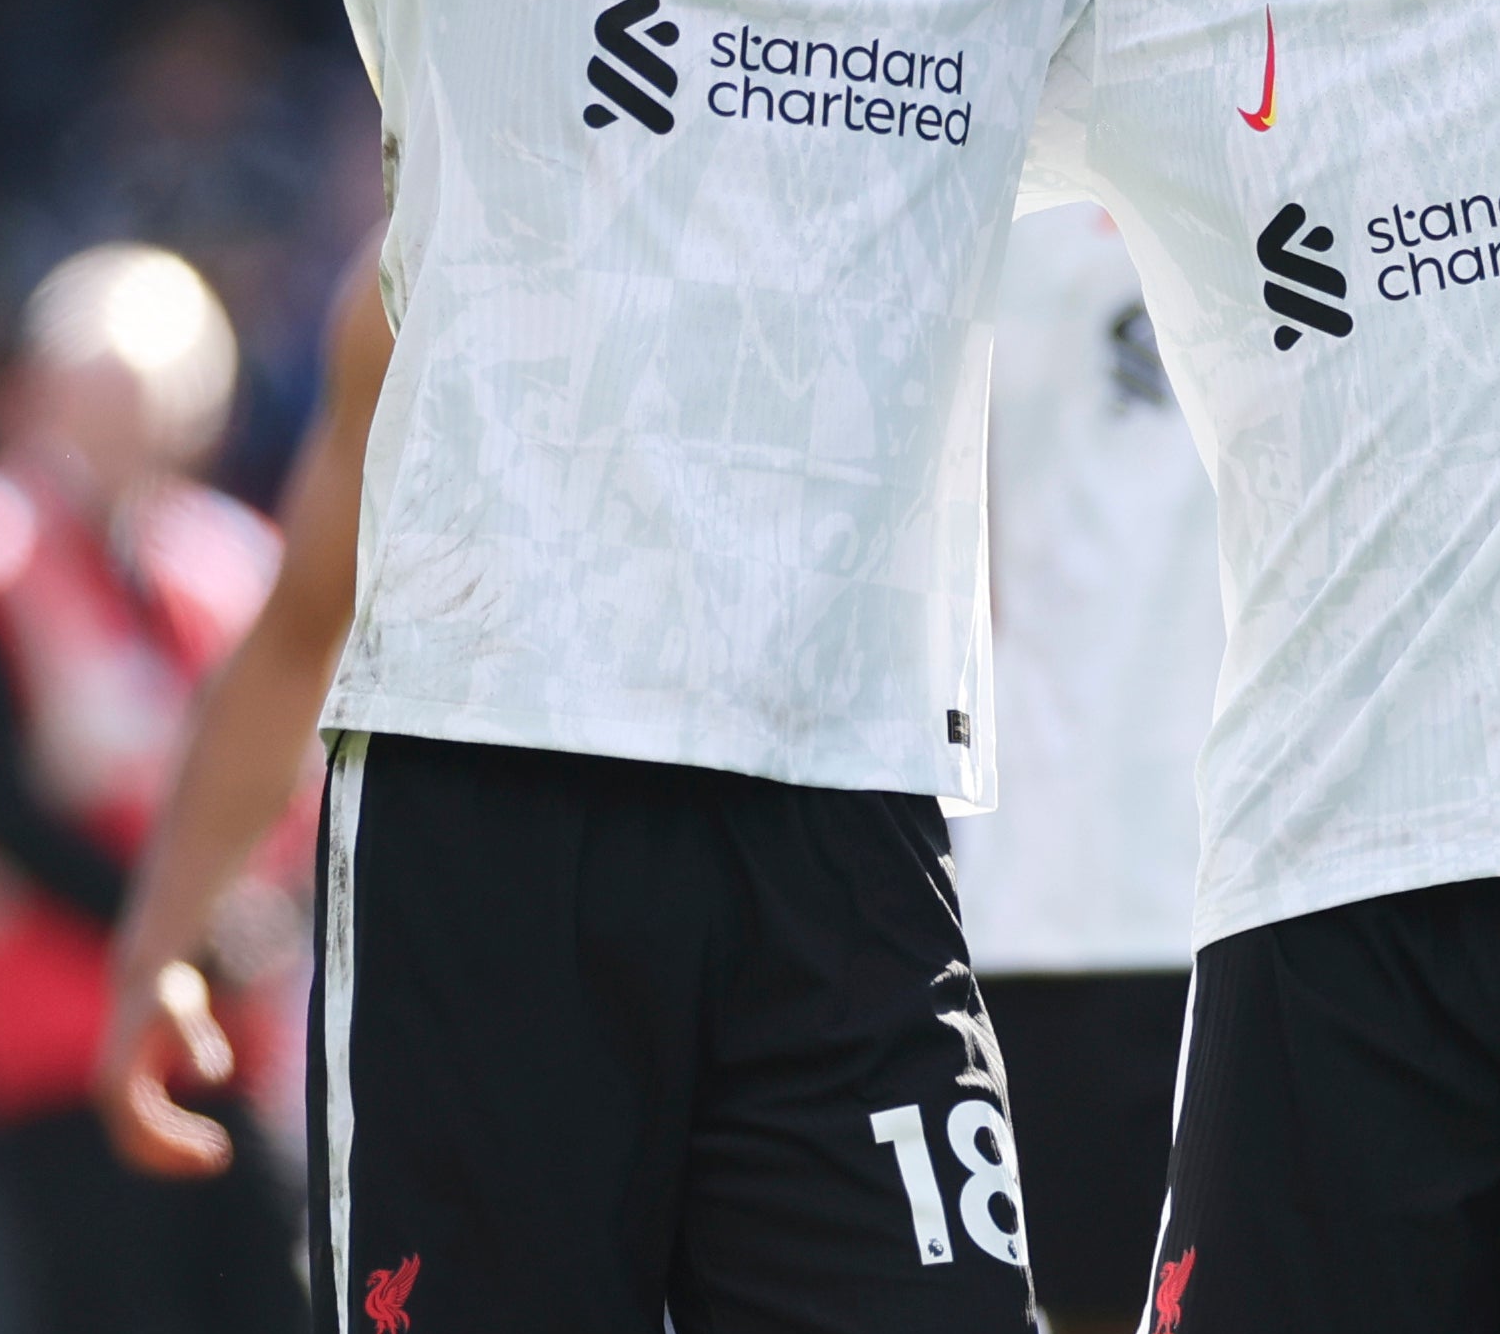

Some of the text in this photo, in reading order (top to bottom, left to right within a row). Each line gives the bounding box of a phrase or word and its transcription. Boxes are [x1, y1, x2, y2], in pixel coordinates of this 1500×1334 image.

[709, 23, 965, 97] standard
[706, 73, 973, 148] chartered
[868, 1099, 1030, 1267] 18
